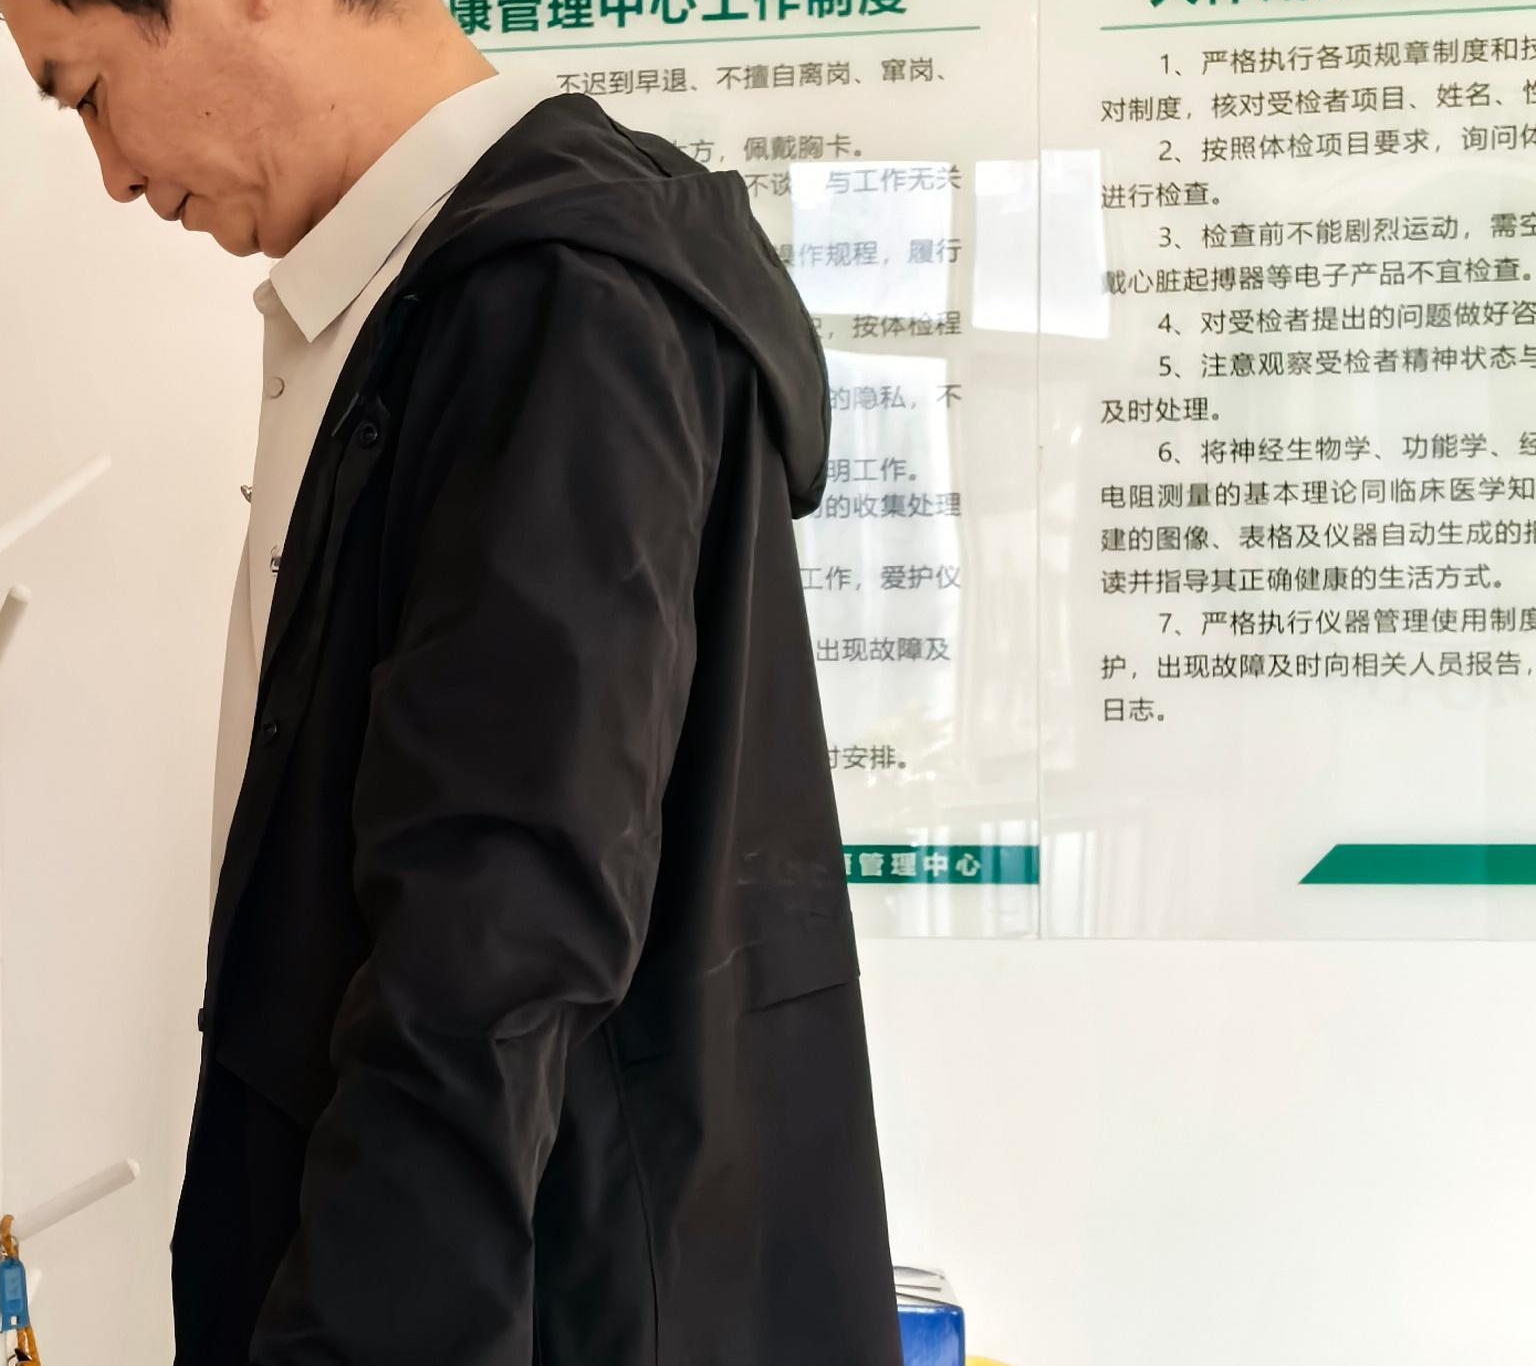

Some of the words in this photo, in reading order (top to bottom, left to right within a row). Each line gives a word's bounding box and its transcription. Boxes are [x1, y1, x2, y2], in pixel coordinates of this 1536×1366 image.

[1101, 181, 1222, 210] 进行检查。
[1101, 396, 1220, 424] 及时处理。
[814, 492, 962, 519] 的收集处理
[1101, 476, 1536, 510] 电阻测量的基本理论同临床医学知
[1101, 563, 1503, 595] 读并指导其正确健康的生活方式。
[816, 637, 951, 662] 出现故障及
[1102, 697, 1166, 723] 日志。
